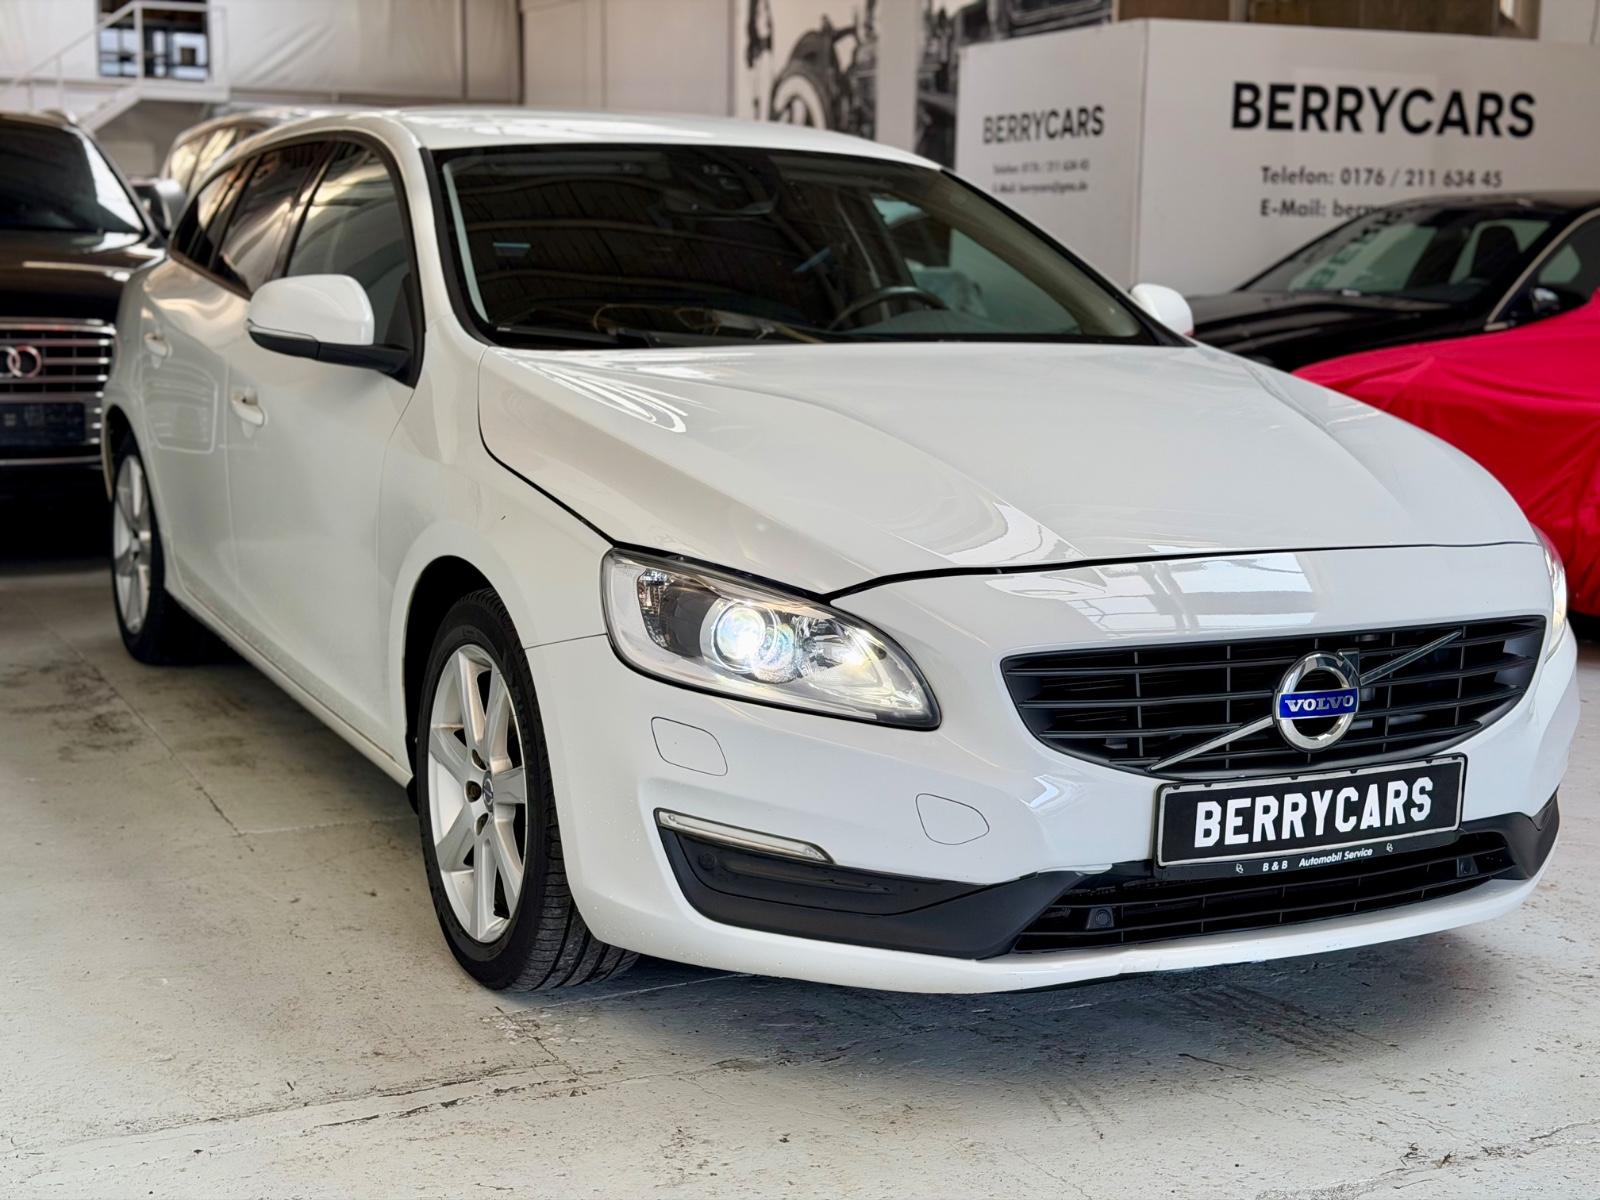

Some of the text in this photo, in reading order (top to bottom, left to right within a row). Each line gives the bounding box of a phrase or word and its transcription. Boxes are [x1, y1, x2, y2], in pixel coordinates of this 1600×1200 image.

[1231, 81, 1536, 137] BERRYCARS
[983, 104, 1105, 144] BERRYCARS
[1260, 165, 1503, 189] Telefon: 0176 / 211 634 45
[1260, 197, 1327, 217] E-Mail:
[1285, 695, 1354, 712] VOLVO
[1194, 776, 1434, 848] BERRYCARS
[1262, 847, 1373, 872] B & B Automobil Service
